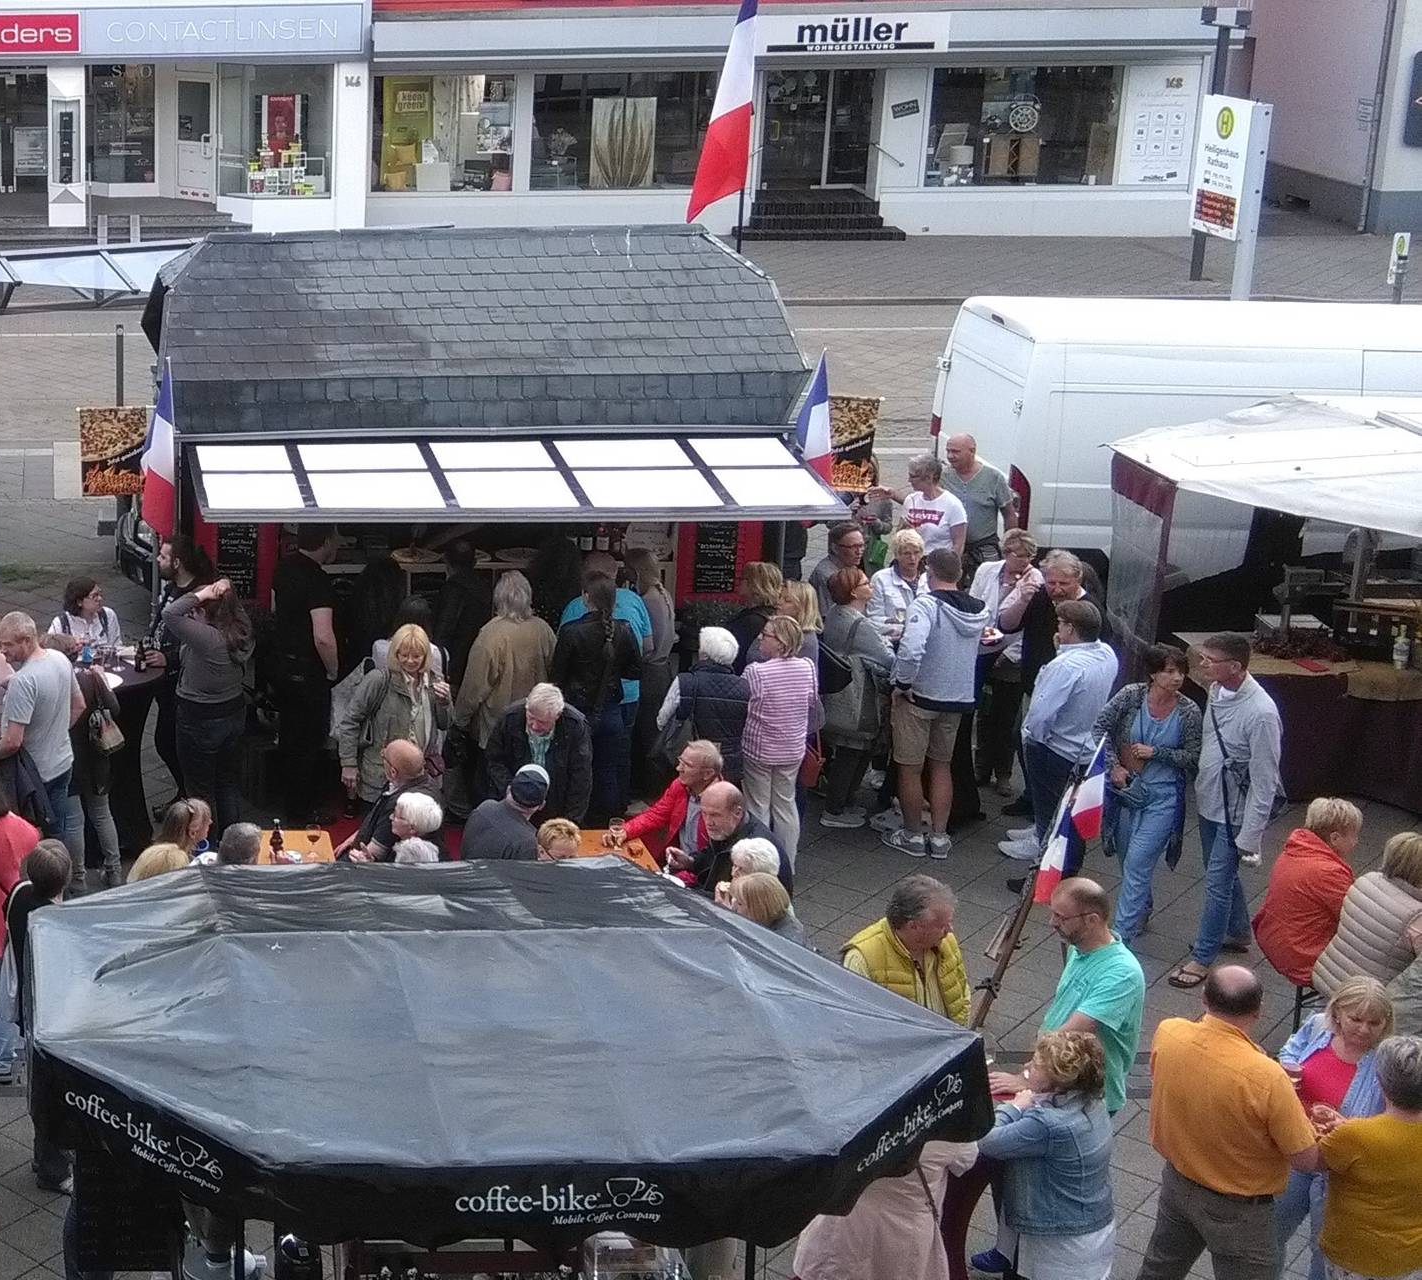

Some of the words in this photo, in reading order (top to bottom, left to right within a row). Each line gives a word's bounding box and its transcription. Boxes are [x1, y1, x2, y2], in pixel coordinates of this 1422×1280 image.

[106, 19, 338, 43] CONTACTLINSEN
[797, 17, 909, 43] müller
[807, 43, 896, 51] WOHNGESTALTUNG
[345, 76, 361, 88] 146
[1165, 77, 1184, 89] 168
[65, 1090, 170, 1155] coffee-bike
[857, 1104, 930, 1172] coffee-bike
[131, 1144, 158, 1164] Mobile
[158, 1158, 182, 1175] Coffee
[182, 1169, 221, 1194] Company
[455, 1184, 599, 1213] coffee-bike
[551, 1215, 585, 1226] Mobile
[586, 1212, 614, 1225] Coffee
[616, 1211, 661, 1224] Company
